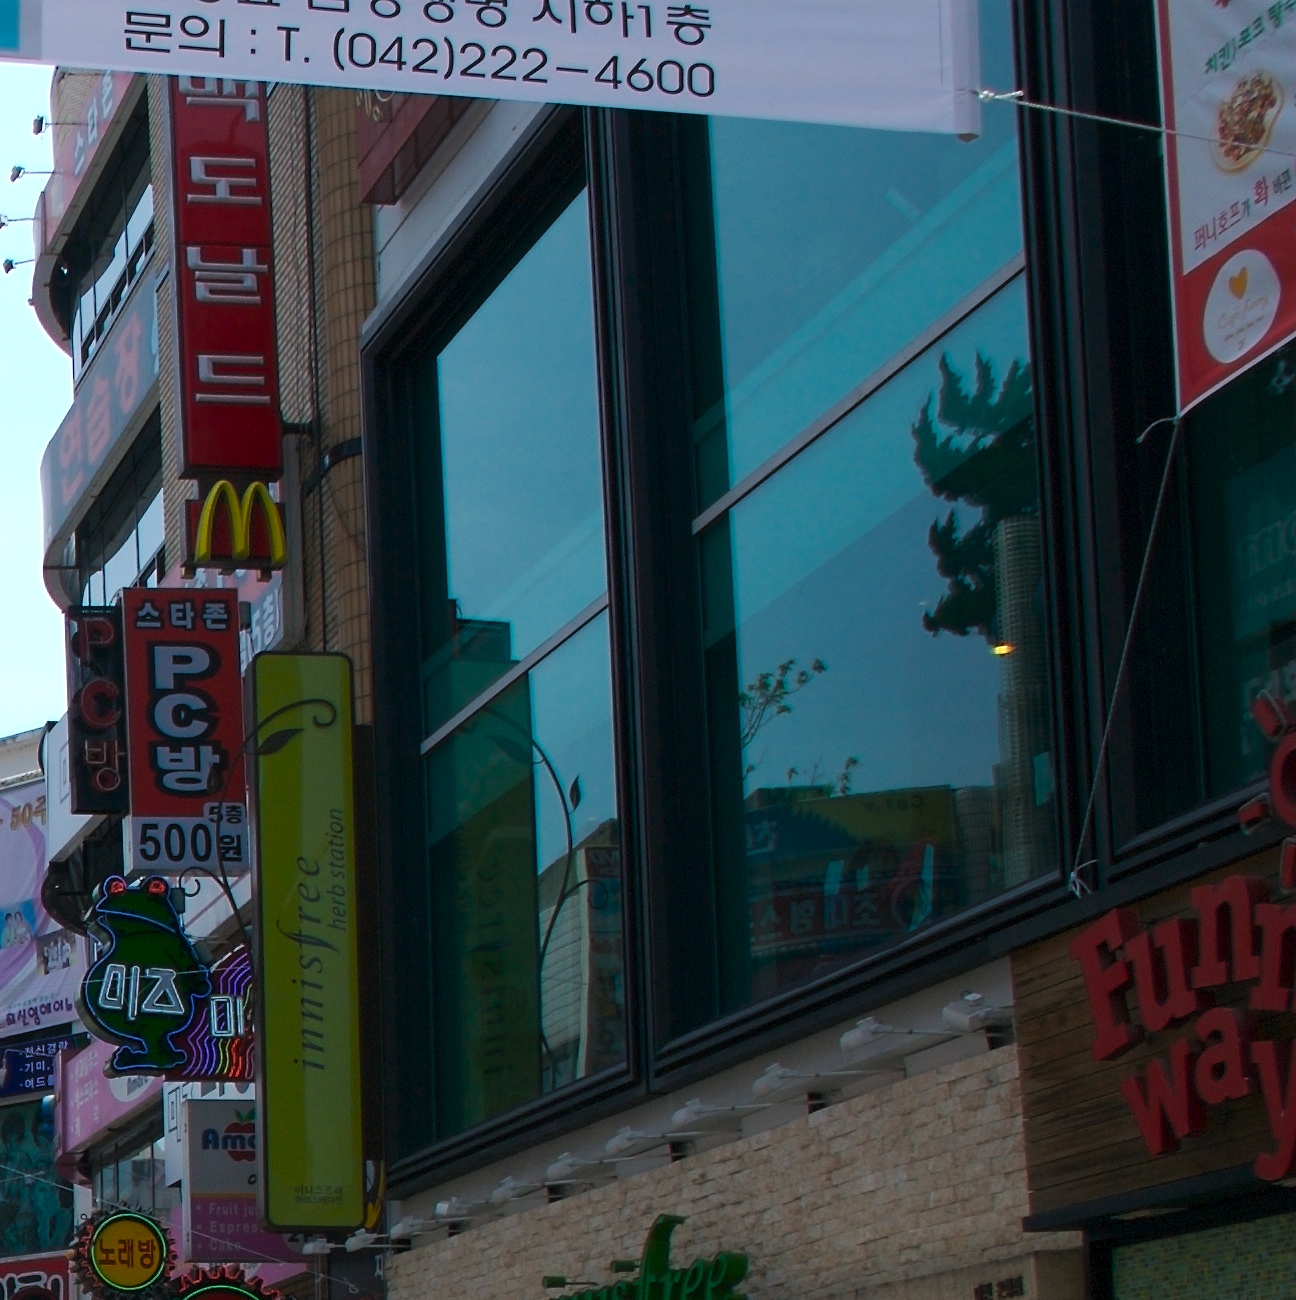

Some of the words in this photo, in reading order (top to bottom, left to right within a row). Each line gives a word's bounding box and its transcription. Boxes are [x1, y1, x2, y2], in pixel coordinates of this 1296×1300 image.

[123, 11, 226, 58] 문의
[332, 26, 716, 98] (042)222-4600
[135, 602, 229, 630] 스타존
[80, 617, 126, 793] PC방
[152, 644, 220, 792] PC방
[207, 804, 244, 825] 5층
[326, 807, 345, 877] station
[326, 881, 347, 932] herb
[276, 854, 342, 1071] innisfree
[99, 963, 186, 1022] 미즈
[208, 1203, 240, 1216] Fruit
[98, 1238, 158, 1269] 노래방
